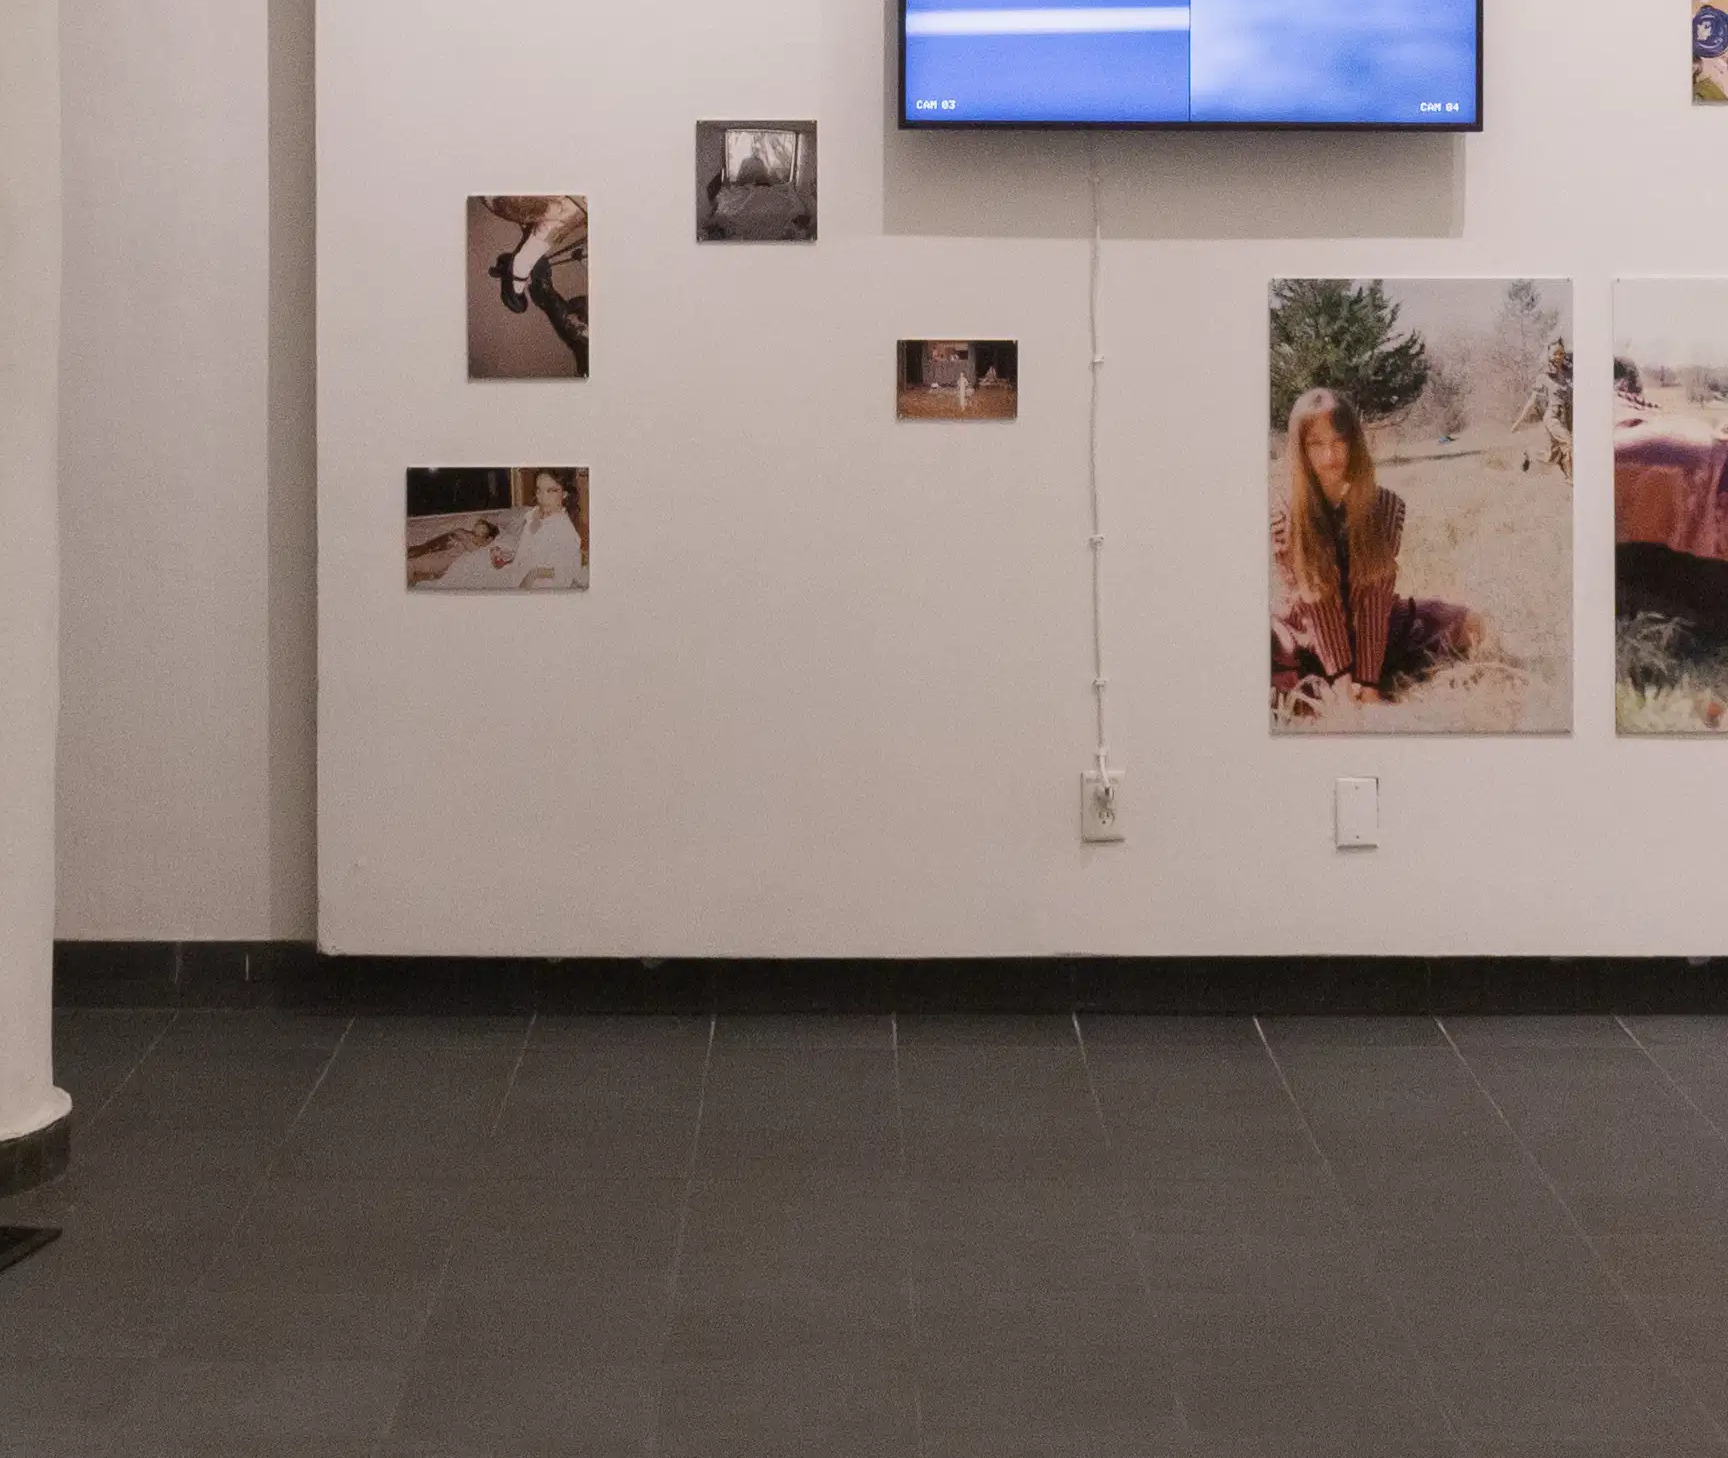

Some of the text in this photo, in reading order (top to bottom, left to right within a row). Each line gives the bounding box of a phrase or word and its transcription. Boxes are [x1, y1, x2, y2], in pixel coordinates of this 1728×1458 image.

[916, 99, 956, 110] CAM 03
[1420, 102, 1442, 112] CAM
